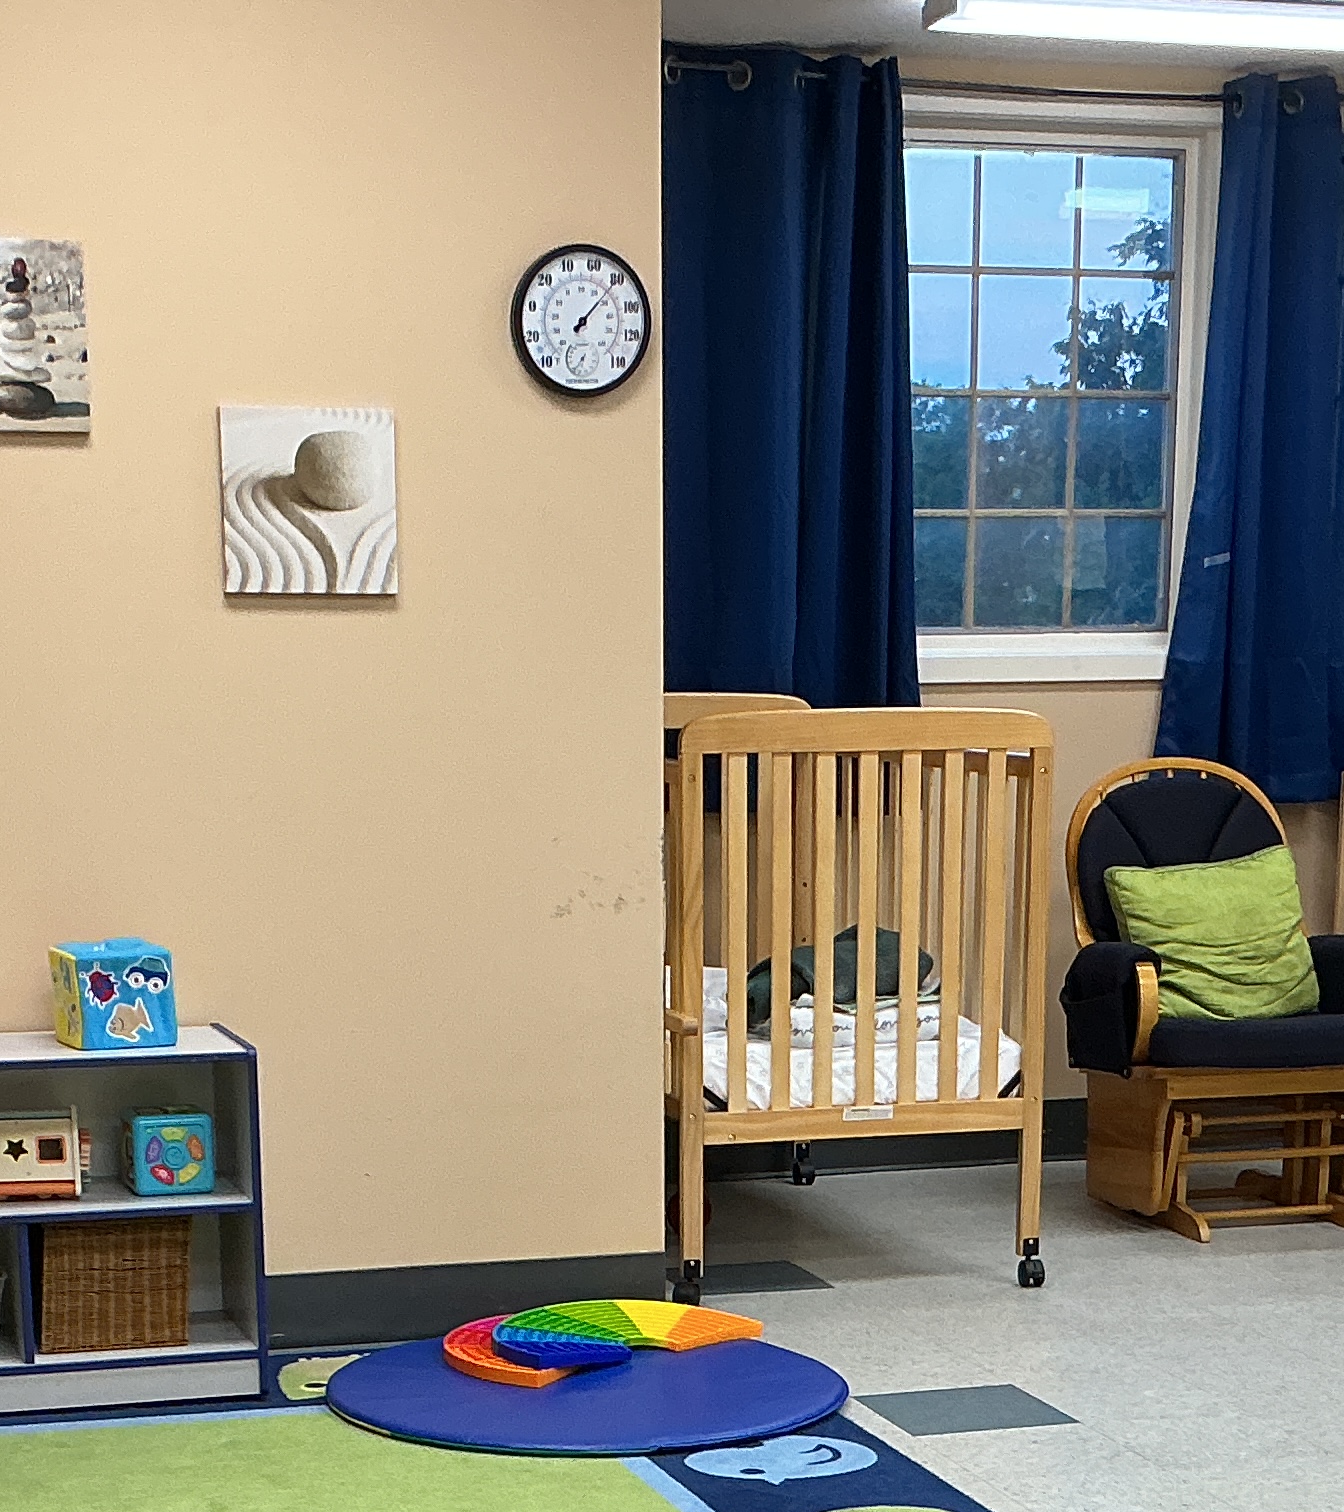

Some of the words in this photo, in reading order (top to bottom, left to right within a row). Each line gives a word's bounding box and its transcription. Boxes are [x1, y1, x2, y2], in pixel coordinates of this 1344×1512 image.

[586, 258, 602, 272] 60
[537, 273, 553, 287] 20
[609, 273, 625, 286] 80
[528, 300, 537, 312] 0
[623, 300, 640, 314] 100
[624, 328, 640, 342] 120
